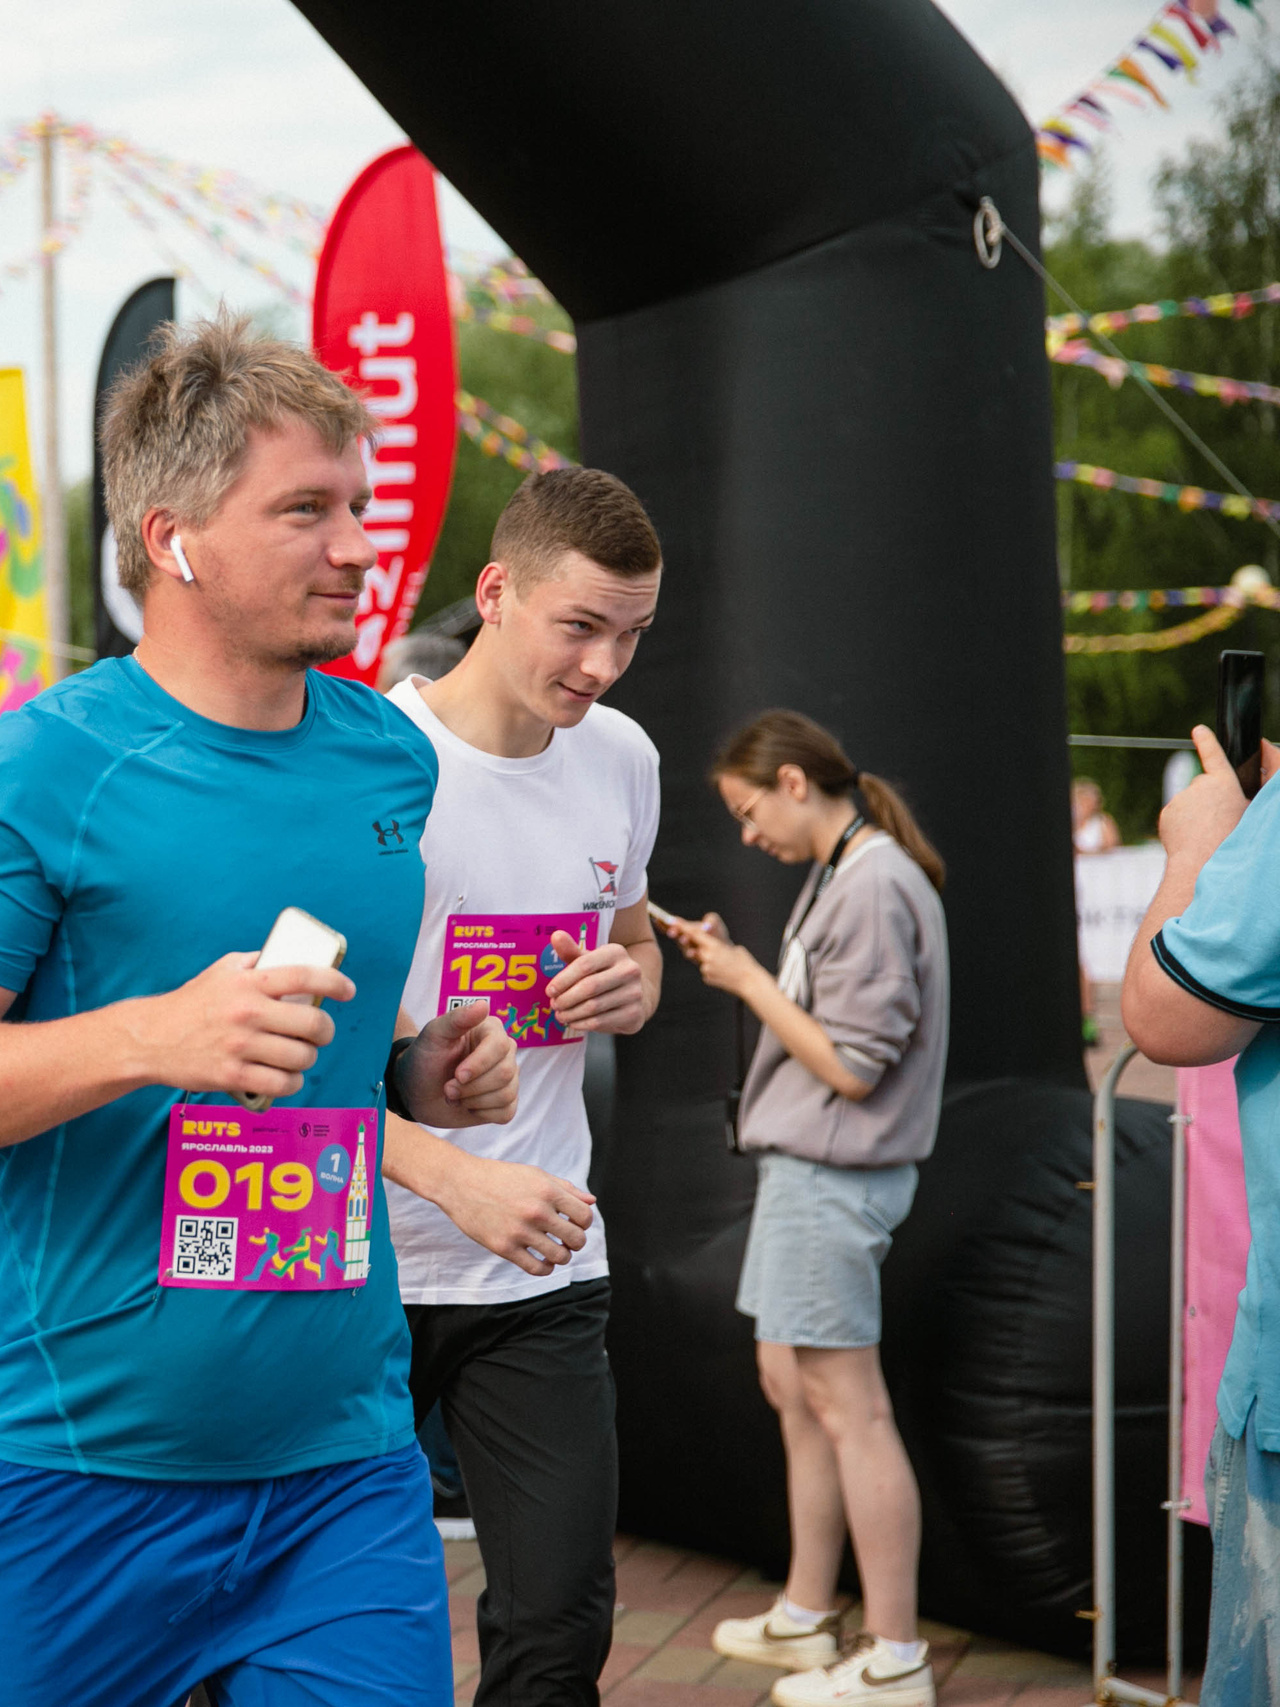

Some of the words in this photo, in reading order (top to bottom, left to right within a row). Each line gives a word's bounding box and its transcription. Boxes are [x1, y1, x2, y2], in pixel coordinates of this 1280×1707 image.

[453, 926, 495, 938] RUTS
[450, 954, 538, 991] 125
[181, 1120, 242, 1137] RUTS
[181, 1142, 248, 1153] ЯРОСЛАВЛЬ
[249, 1145, 273, 1154] 2023
[329, 1152, 341, 1173] 1
[178, 1159, 314, 1212] 019
[320, 1173, 344, 1184] ВОЛНА
